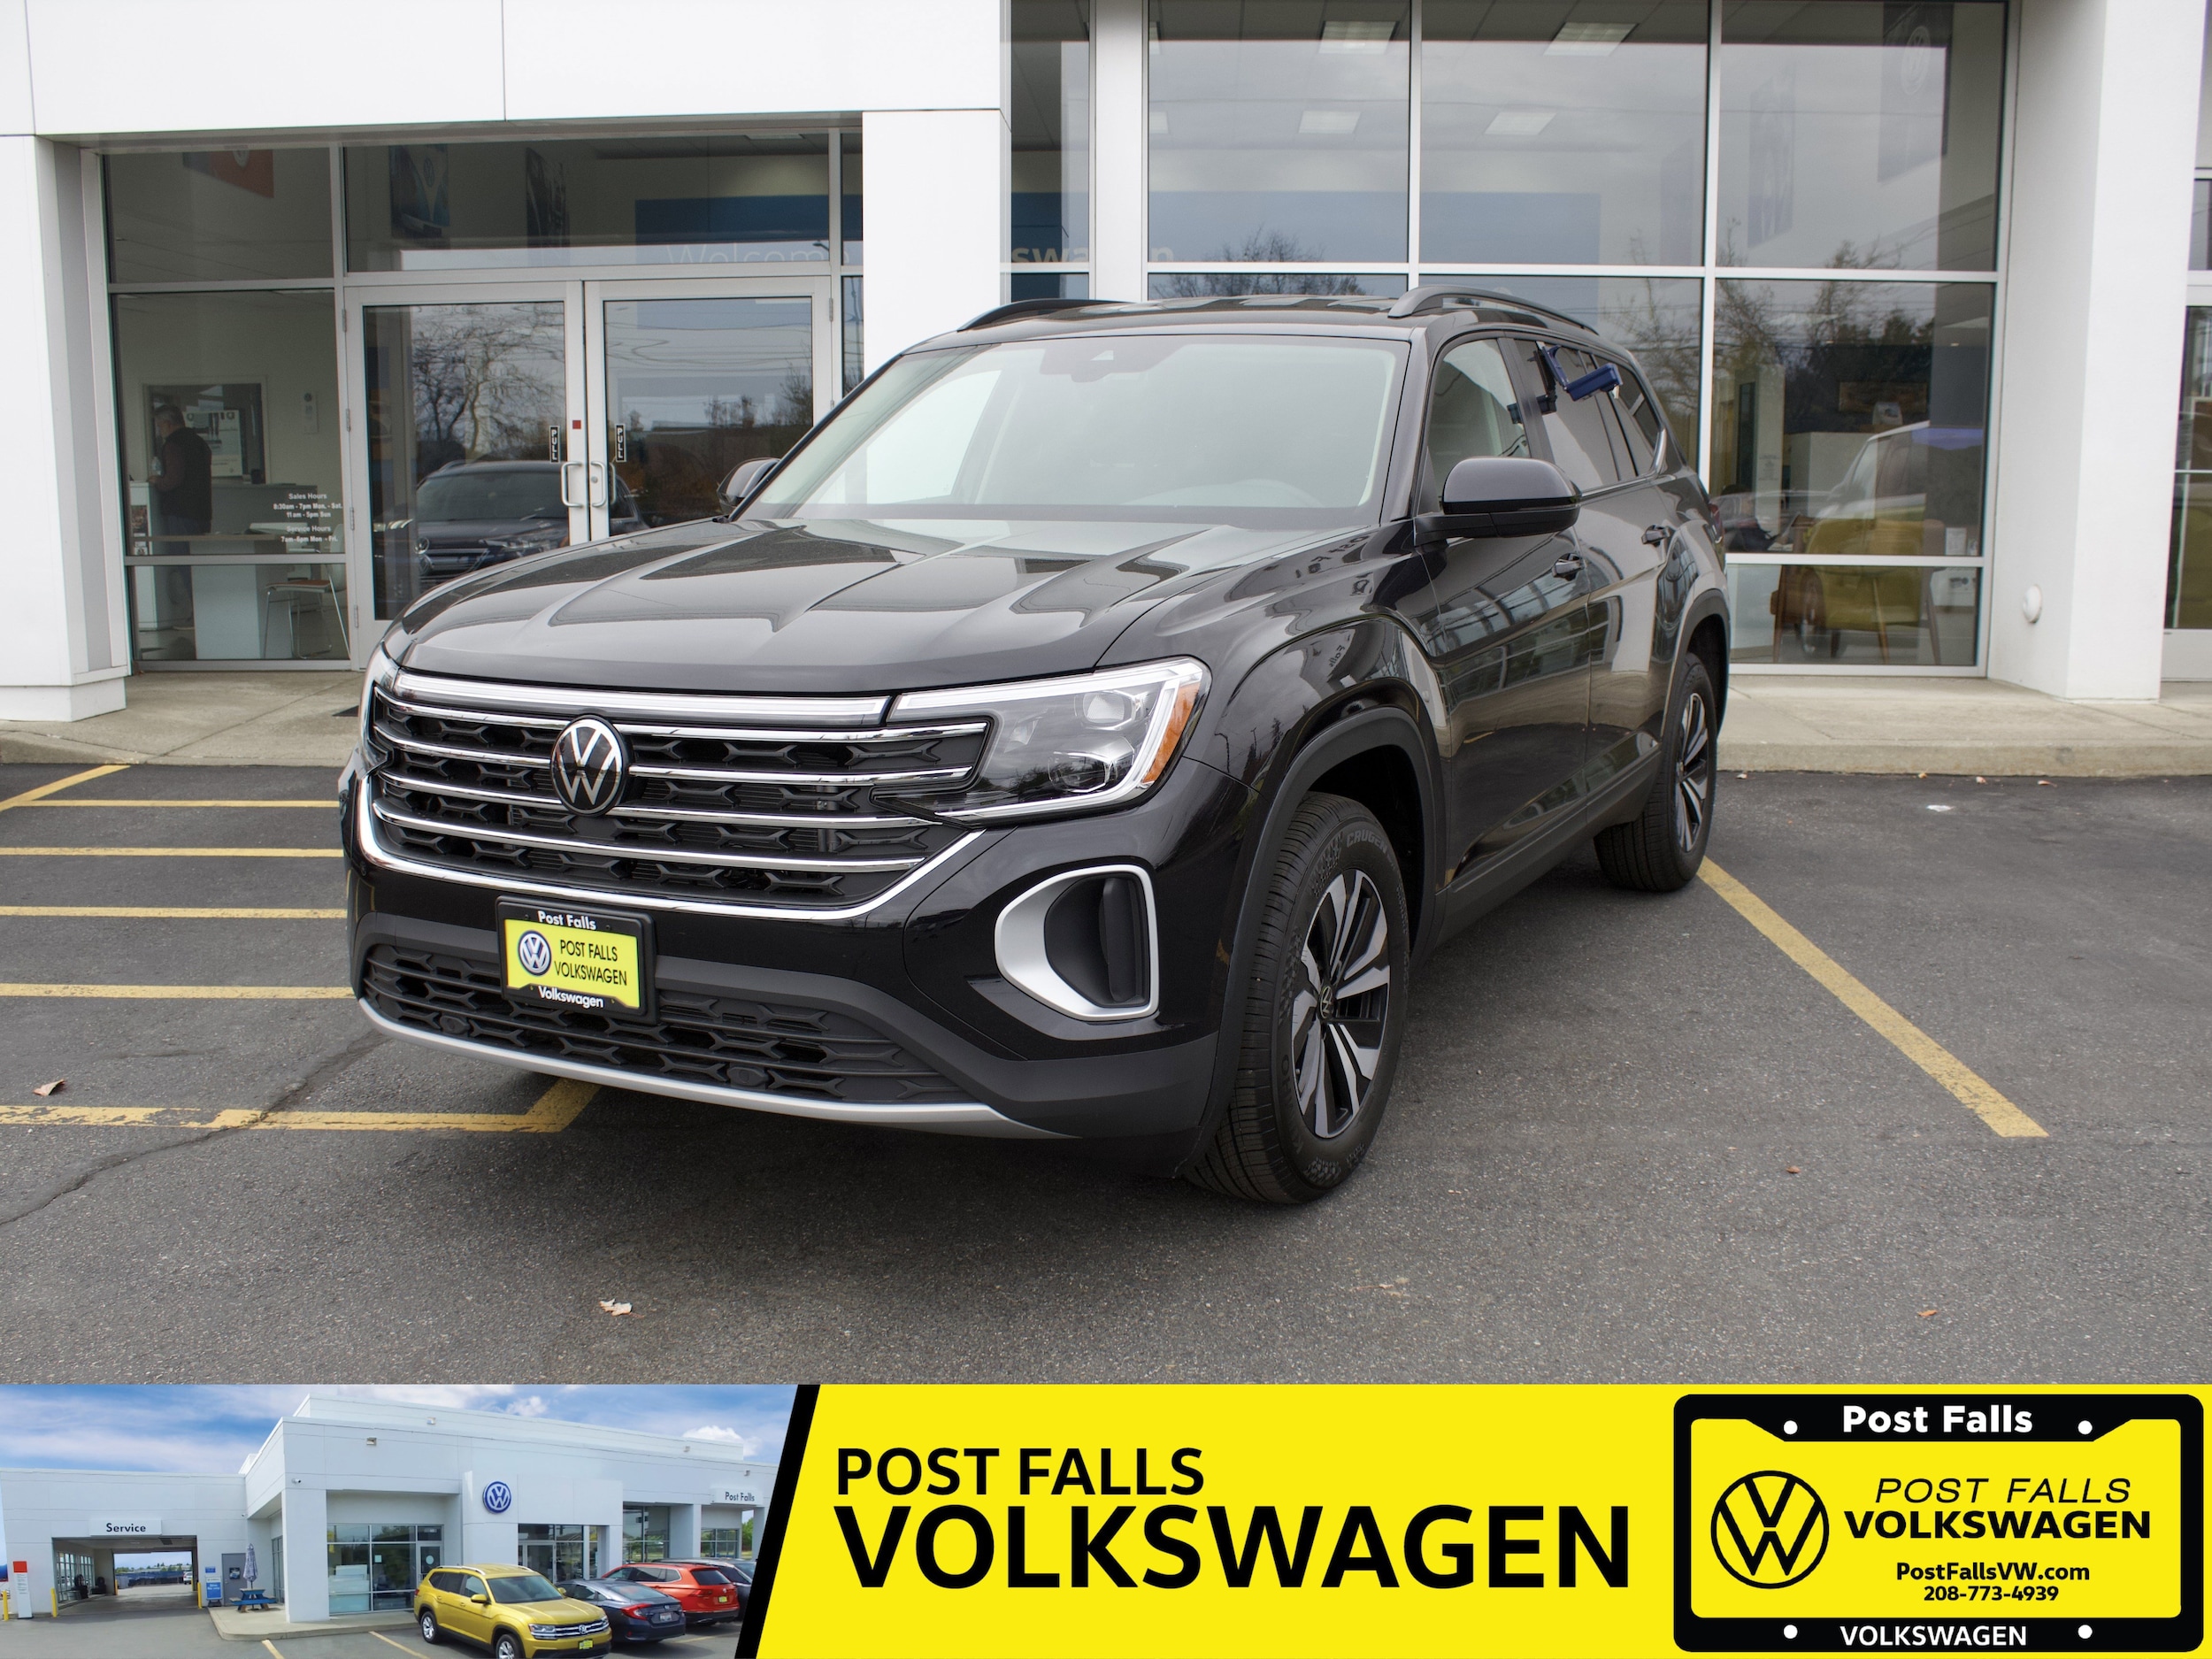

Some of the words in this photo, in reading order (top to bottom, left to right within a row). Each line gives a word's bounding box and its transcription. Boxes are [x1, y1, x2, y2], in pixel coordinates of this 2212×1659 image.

[1346, 829, 1388, 855] CRUGEN
[537, 910, 564, 926] Post
[566, 914, 596, 930] Falls
[560, 939, 586, 958] POST
[588, 943, 618, 962] FALLS
[554, 960, 627, 986] VOLKSWAGEN
[538, 985, 603, 1009] Volkswagen
